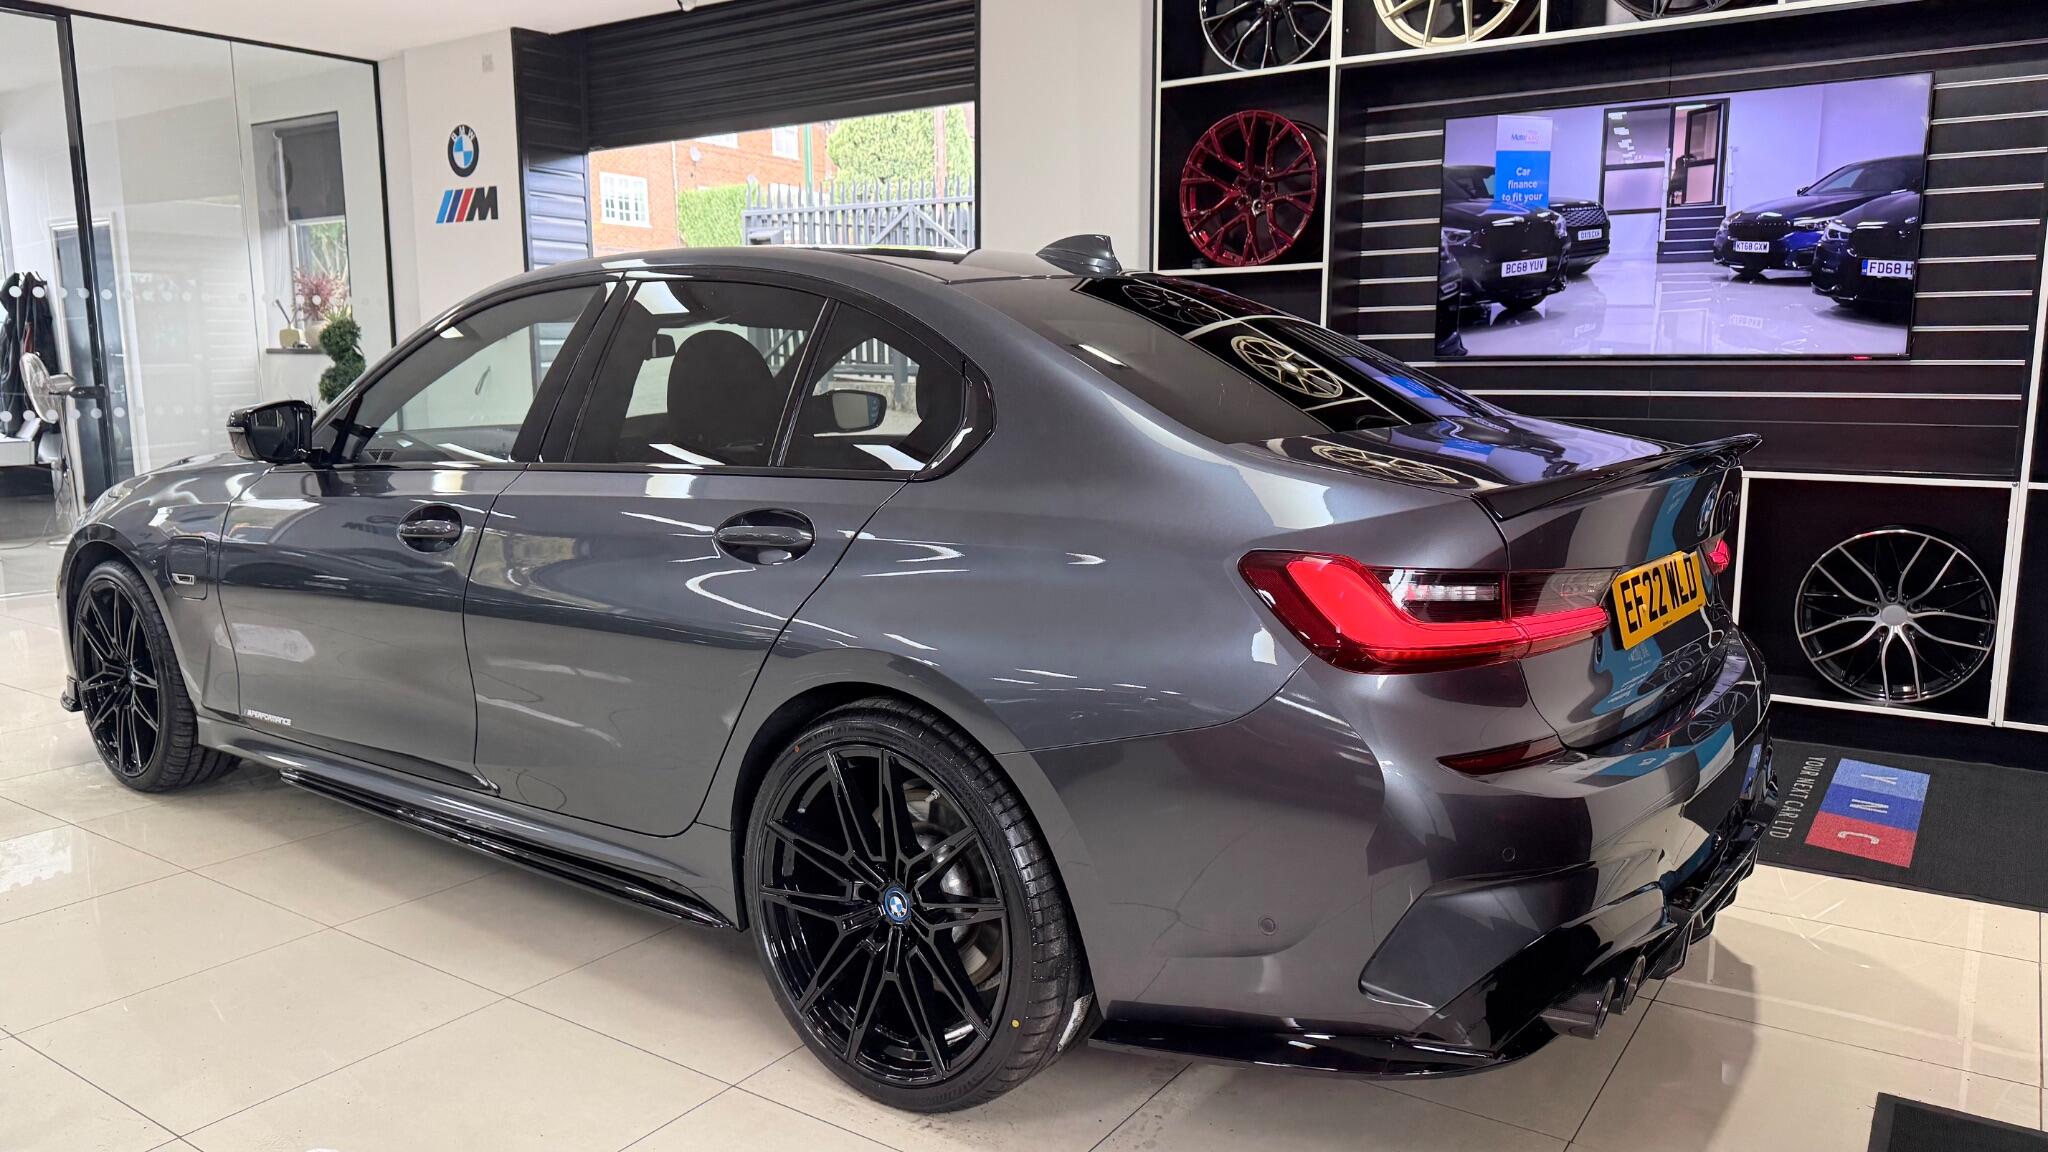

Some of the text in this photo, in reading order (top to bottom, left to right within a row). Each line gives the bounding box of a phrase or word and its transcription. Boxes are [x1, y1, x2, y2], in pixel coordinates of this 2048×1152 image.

[1516, 166, 1531, 176] Car
[1507, 180, 1538, 189] finance
[465, 185, 499, 222] M
[1502, 192, 1543, 204] to fit your
[1736, 241, 1768, 251] KT68 GXW
[1505, 260, 1545, 274] BC68 YUV
[1869, 262, 1913, 275] FD68 H
[1620, 557, 1698, 634] EF22 WLD
[1769, 757, 1827, 839] YOUR NEXT CAR LTD
